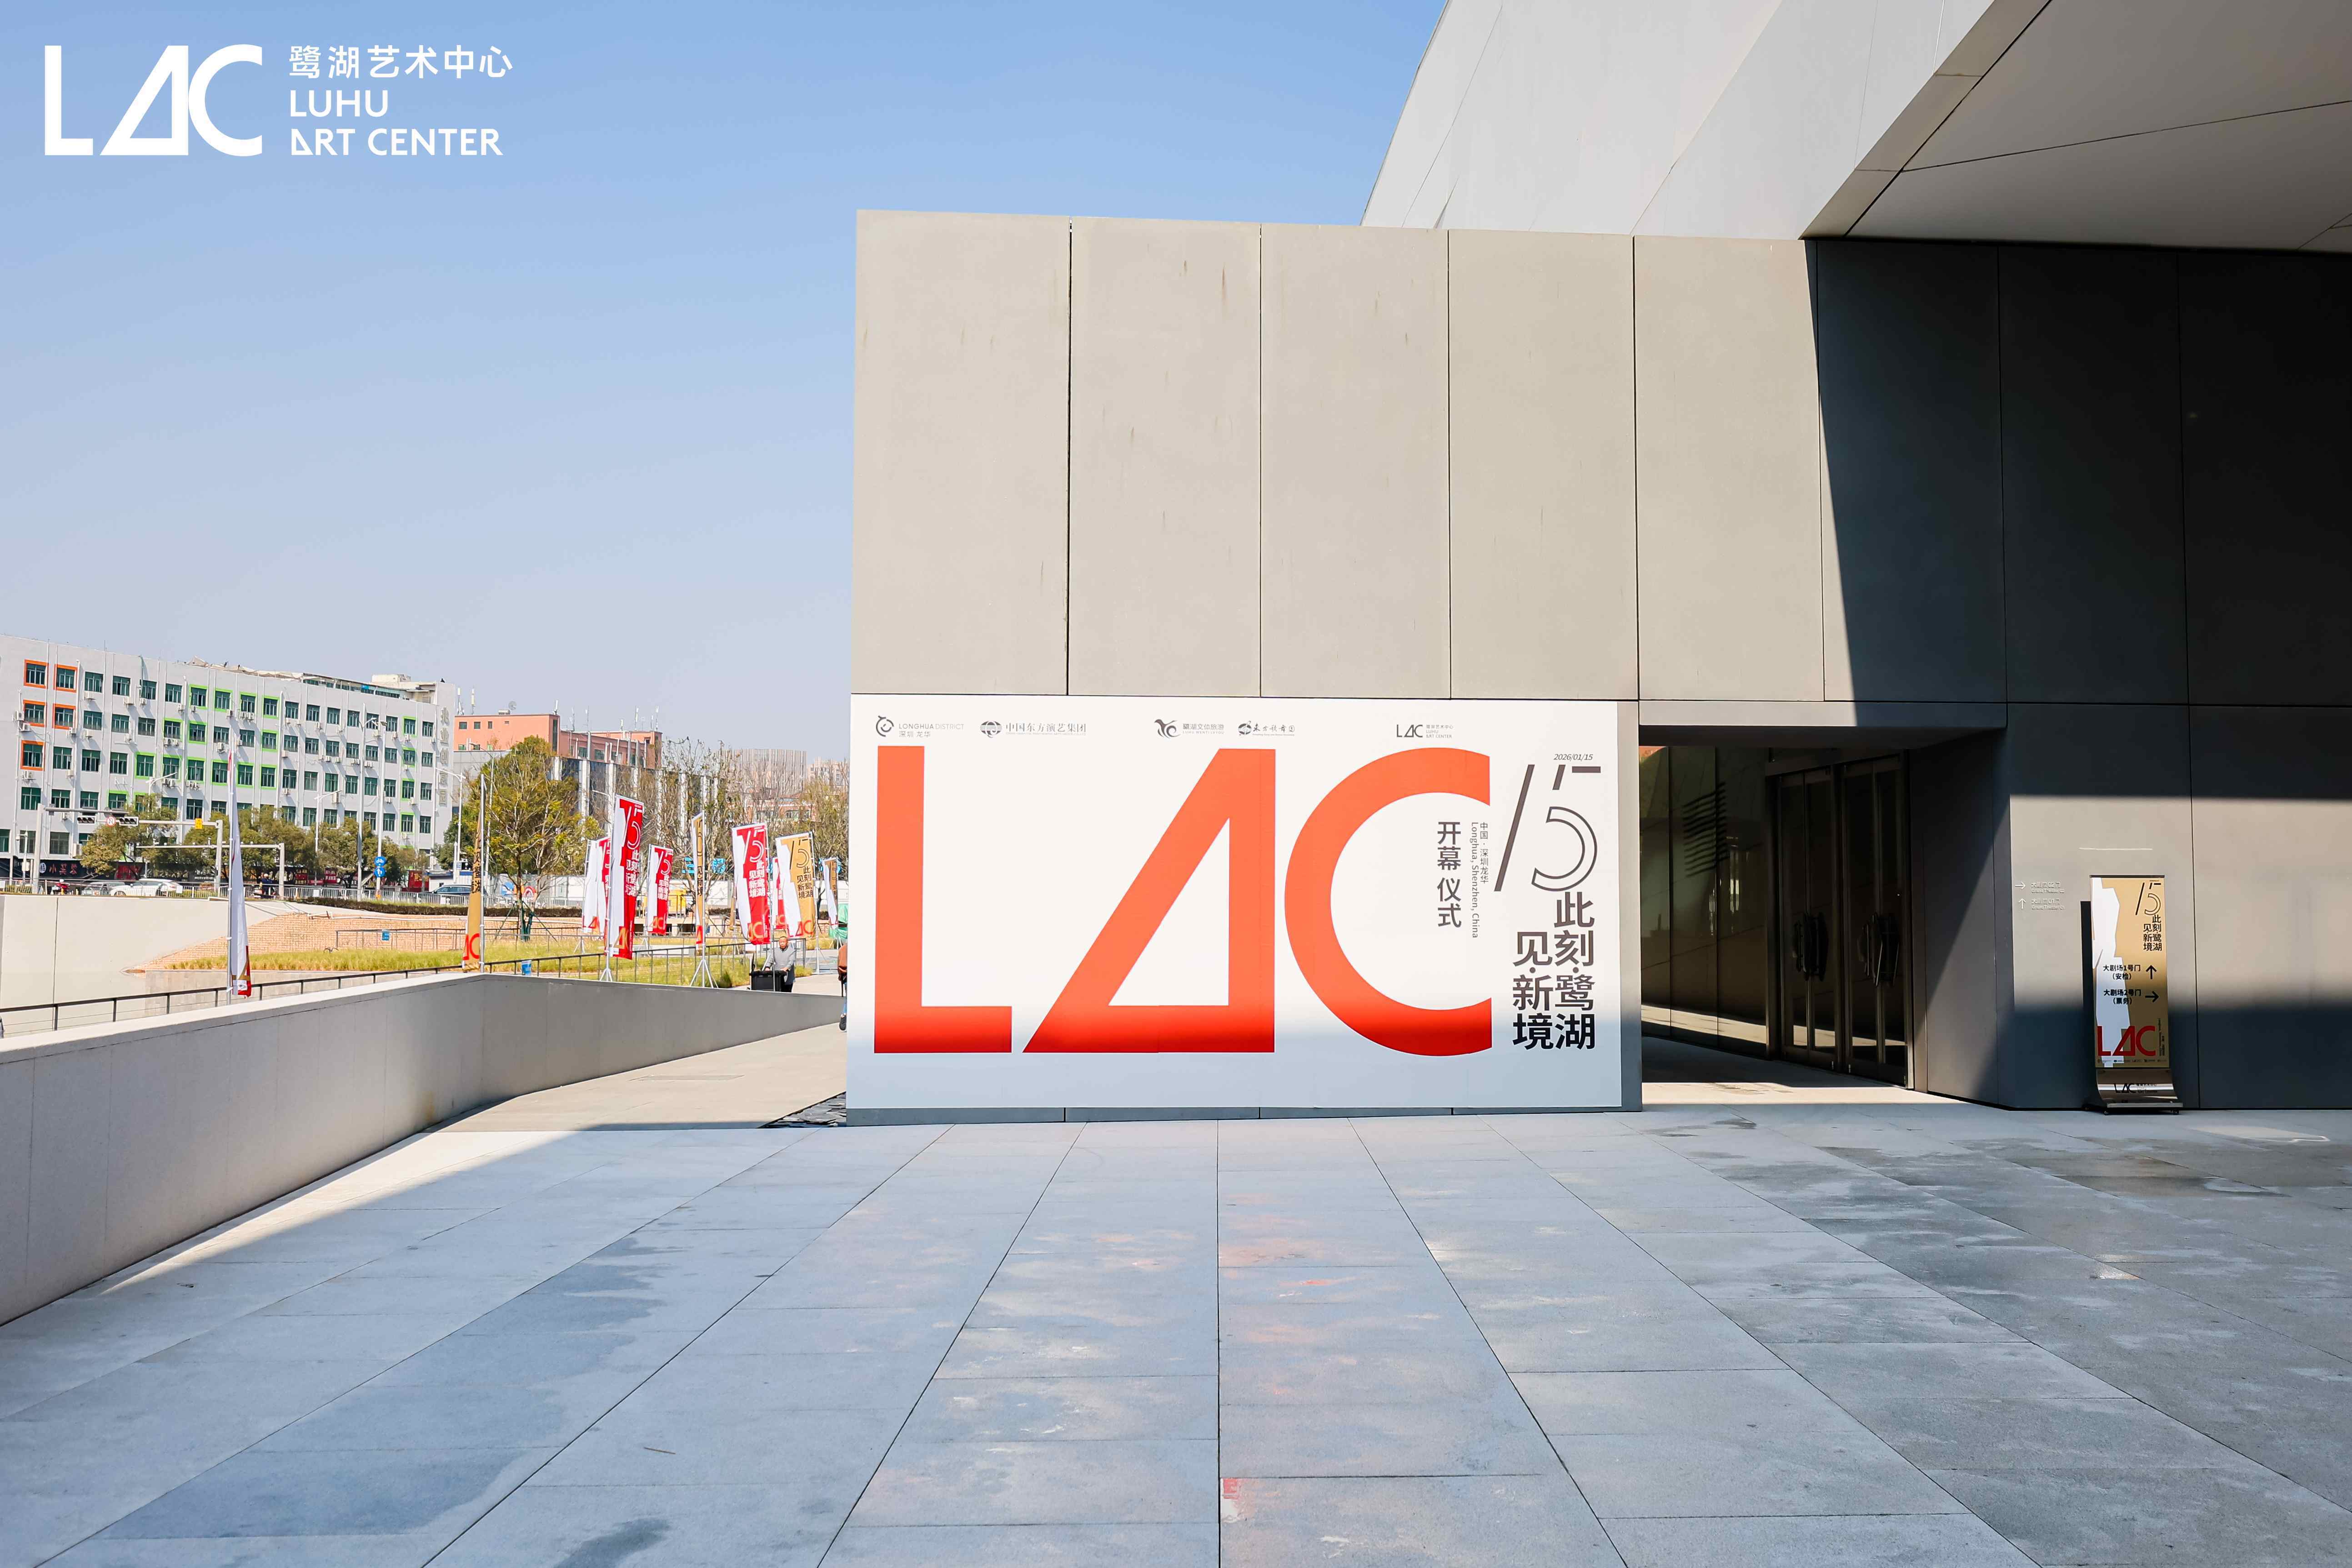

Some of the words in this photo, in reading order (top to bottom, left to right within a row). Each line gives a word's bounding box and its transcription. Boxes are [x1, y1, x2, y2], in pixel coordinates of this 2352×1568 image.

[1006, 722, 1086, 732] 中国东方演艺集团
[1396, 724, 1423, 738] LAC
[1469, 822, 1479, 862] Longhua,
[874, 746, 1492, 1057] LAC
[1470, 865, 1480, 911] Shenzhen,
[1472, 913, 1480, 938] China
[2097, 1025, 2156, 1056] LAC
[2114, 1083, 2137, 1093] LAC
